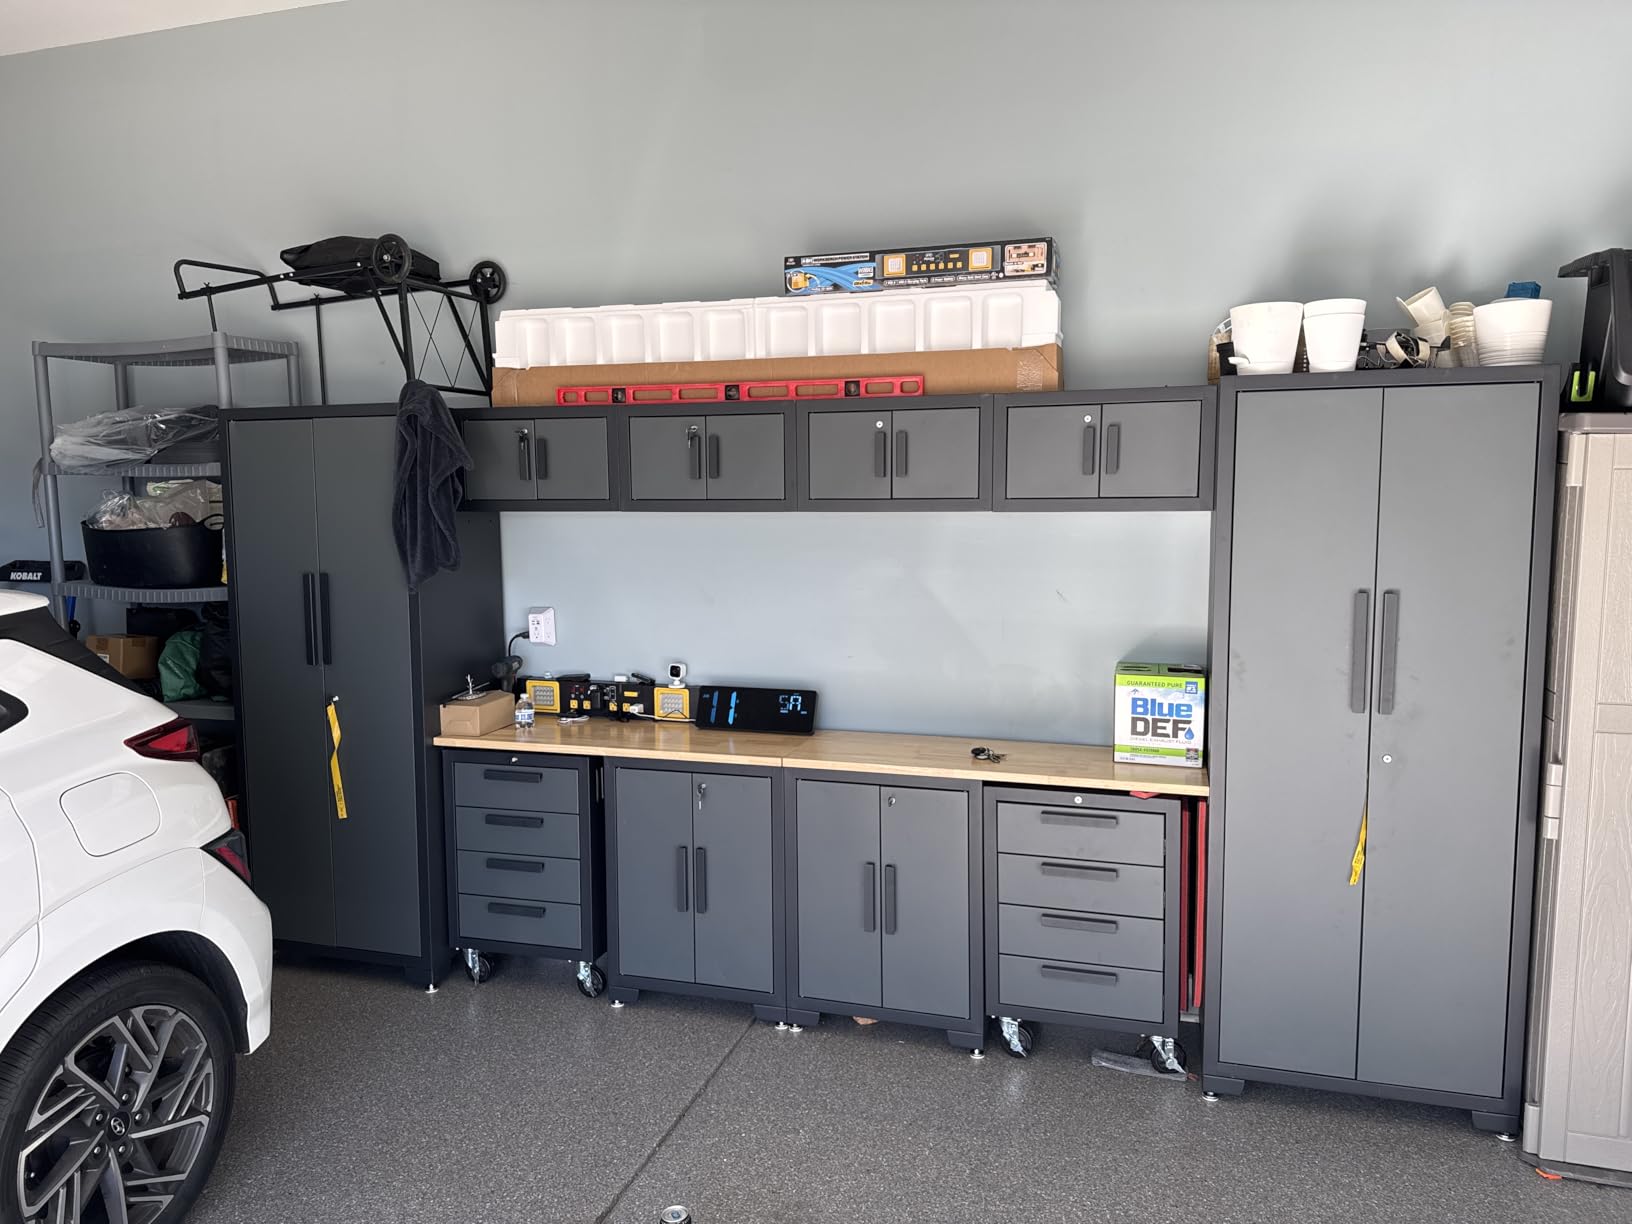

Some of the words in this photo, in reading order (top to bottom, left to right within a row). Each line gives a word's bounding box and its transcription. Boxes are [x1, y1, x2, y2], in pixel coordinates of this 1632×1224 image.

[10, 571, 42, 580] KOBALT
[1126, 680, 1166, 688] GUARANTEED
[1131, 697, 1193, 718] Blue
[1130, 716, 1192, 739] DEF
